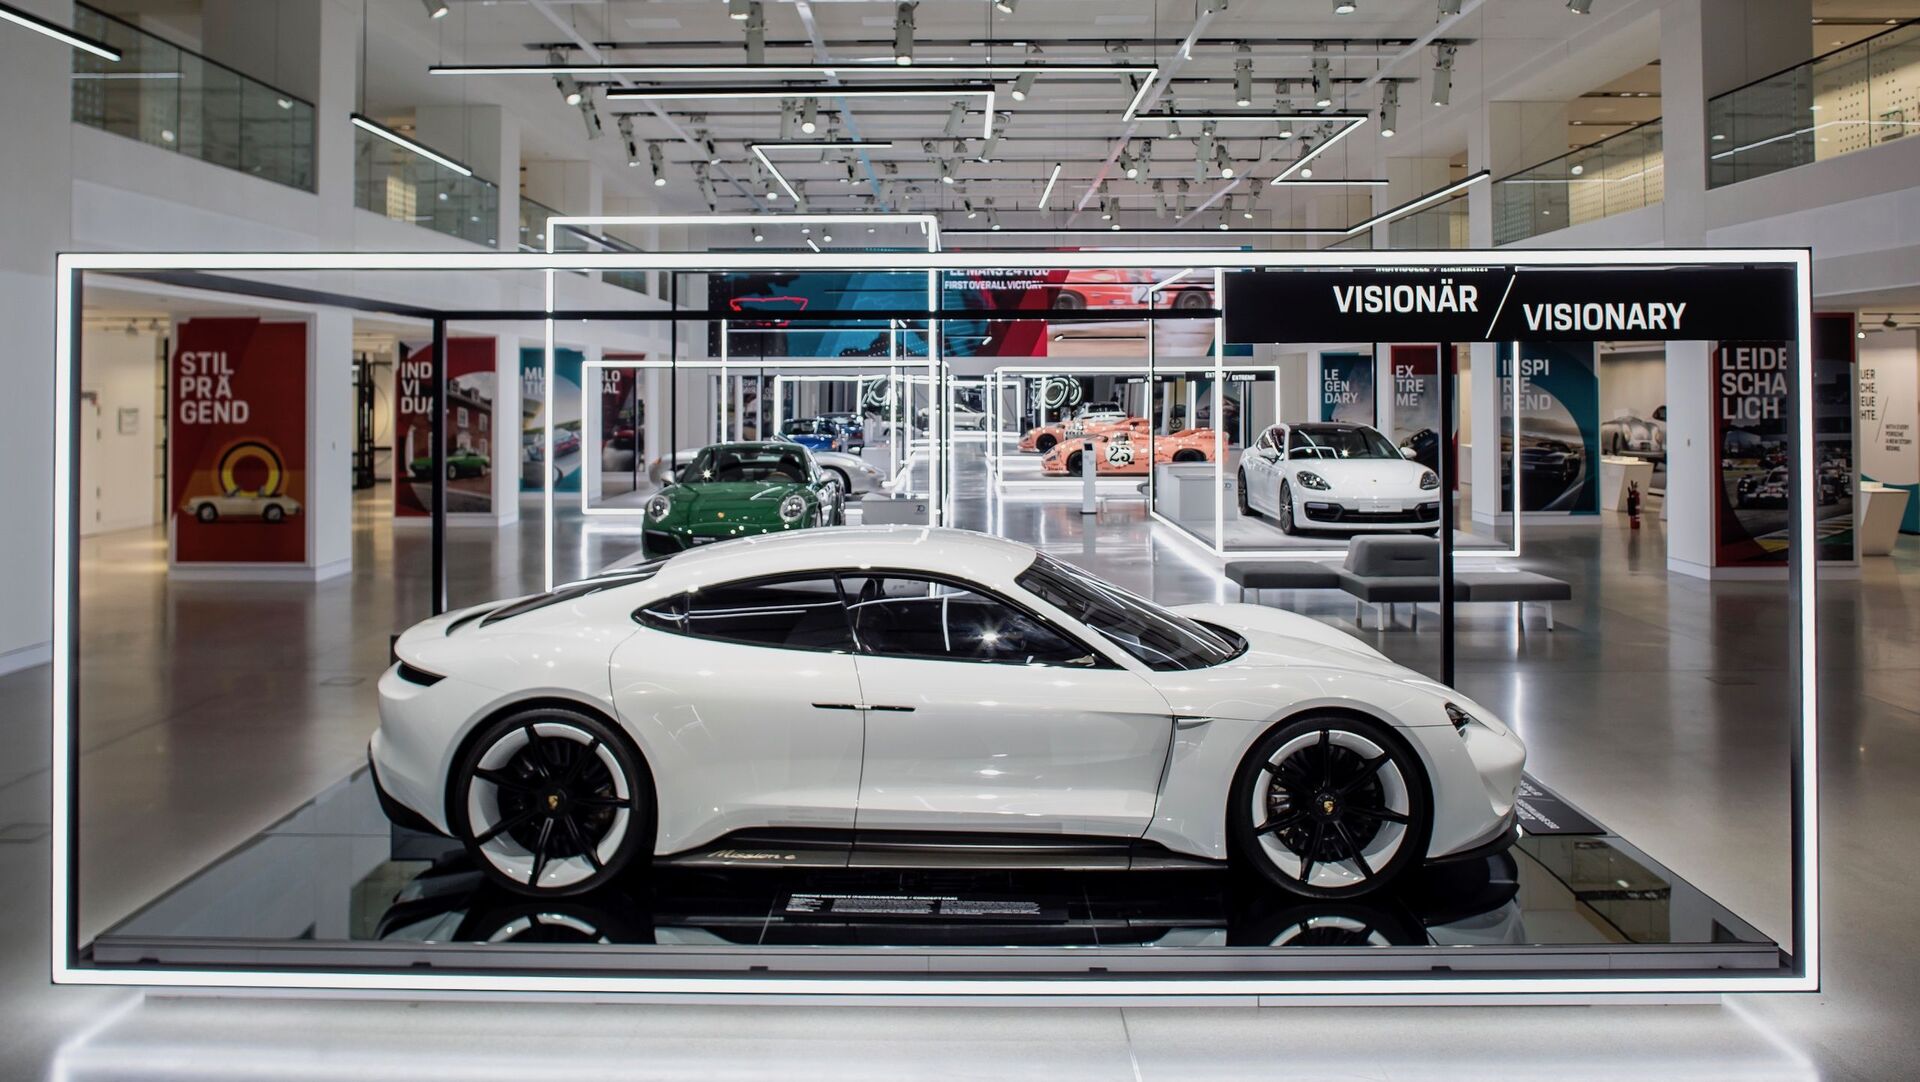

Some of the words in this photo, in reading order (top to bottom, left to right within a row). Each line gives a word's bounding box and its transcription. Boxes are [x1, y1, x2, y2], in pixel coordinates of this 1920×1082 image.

[944, 280, 969, 290] FIRST
[968, 280, 1007, 290] OVERALL
[1332, 278, 1479, 313] VISIONÄR
[1522, 302, 1687, 331] VISIONARY
[180, 352, 235, 375] STIL
[1324, 368, 1340, 381] LE
[1395, 364, 1415, 379] EX
[180, 375, 232, 399] PRÄ
[401, 379, 420, 397] VI
[1324, 380, 1350, 392] GEN
[1396, 378, 1424, 393] TRE
[1324, 392, 1359, 404] DARY
[1396, 393, 1418, 407] ME
[180, 400, 250, 425] GEND
[1722, 396, 1780, 420] LICH
